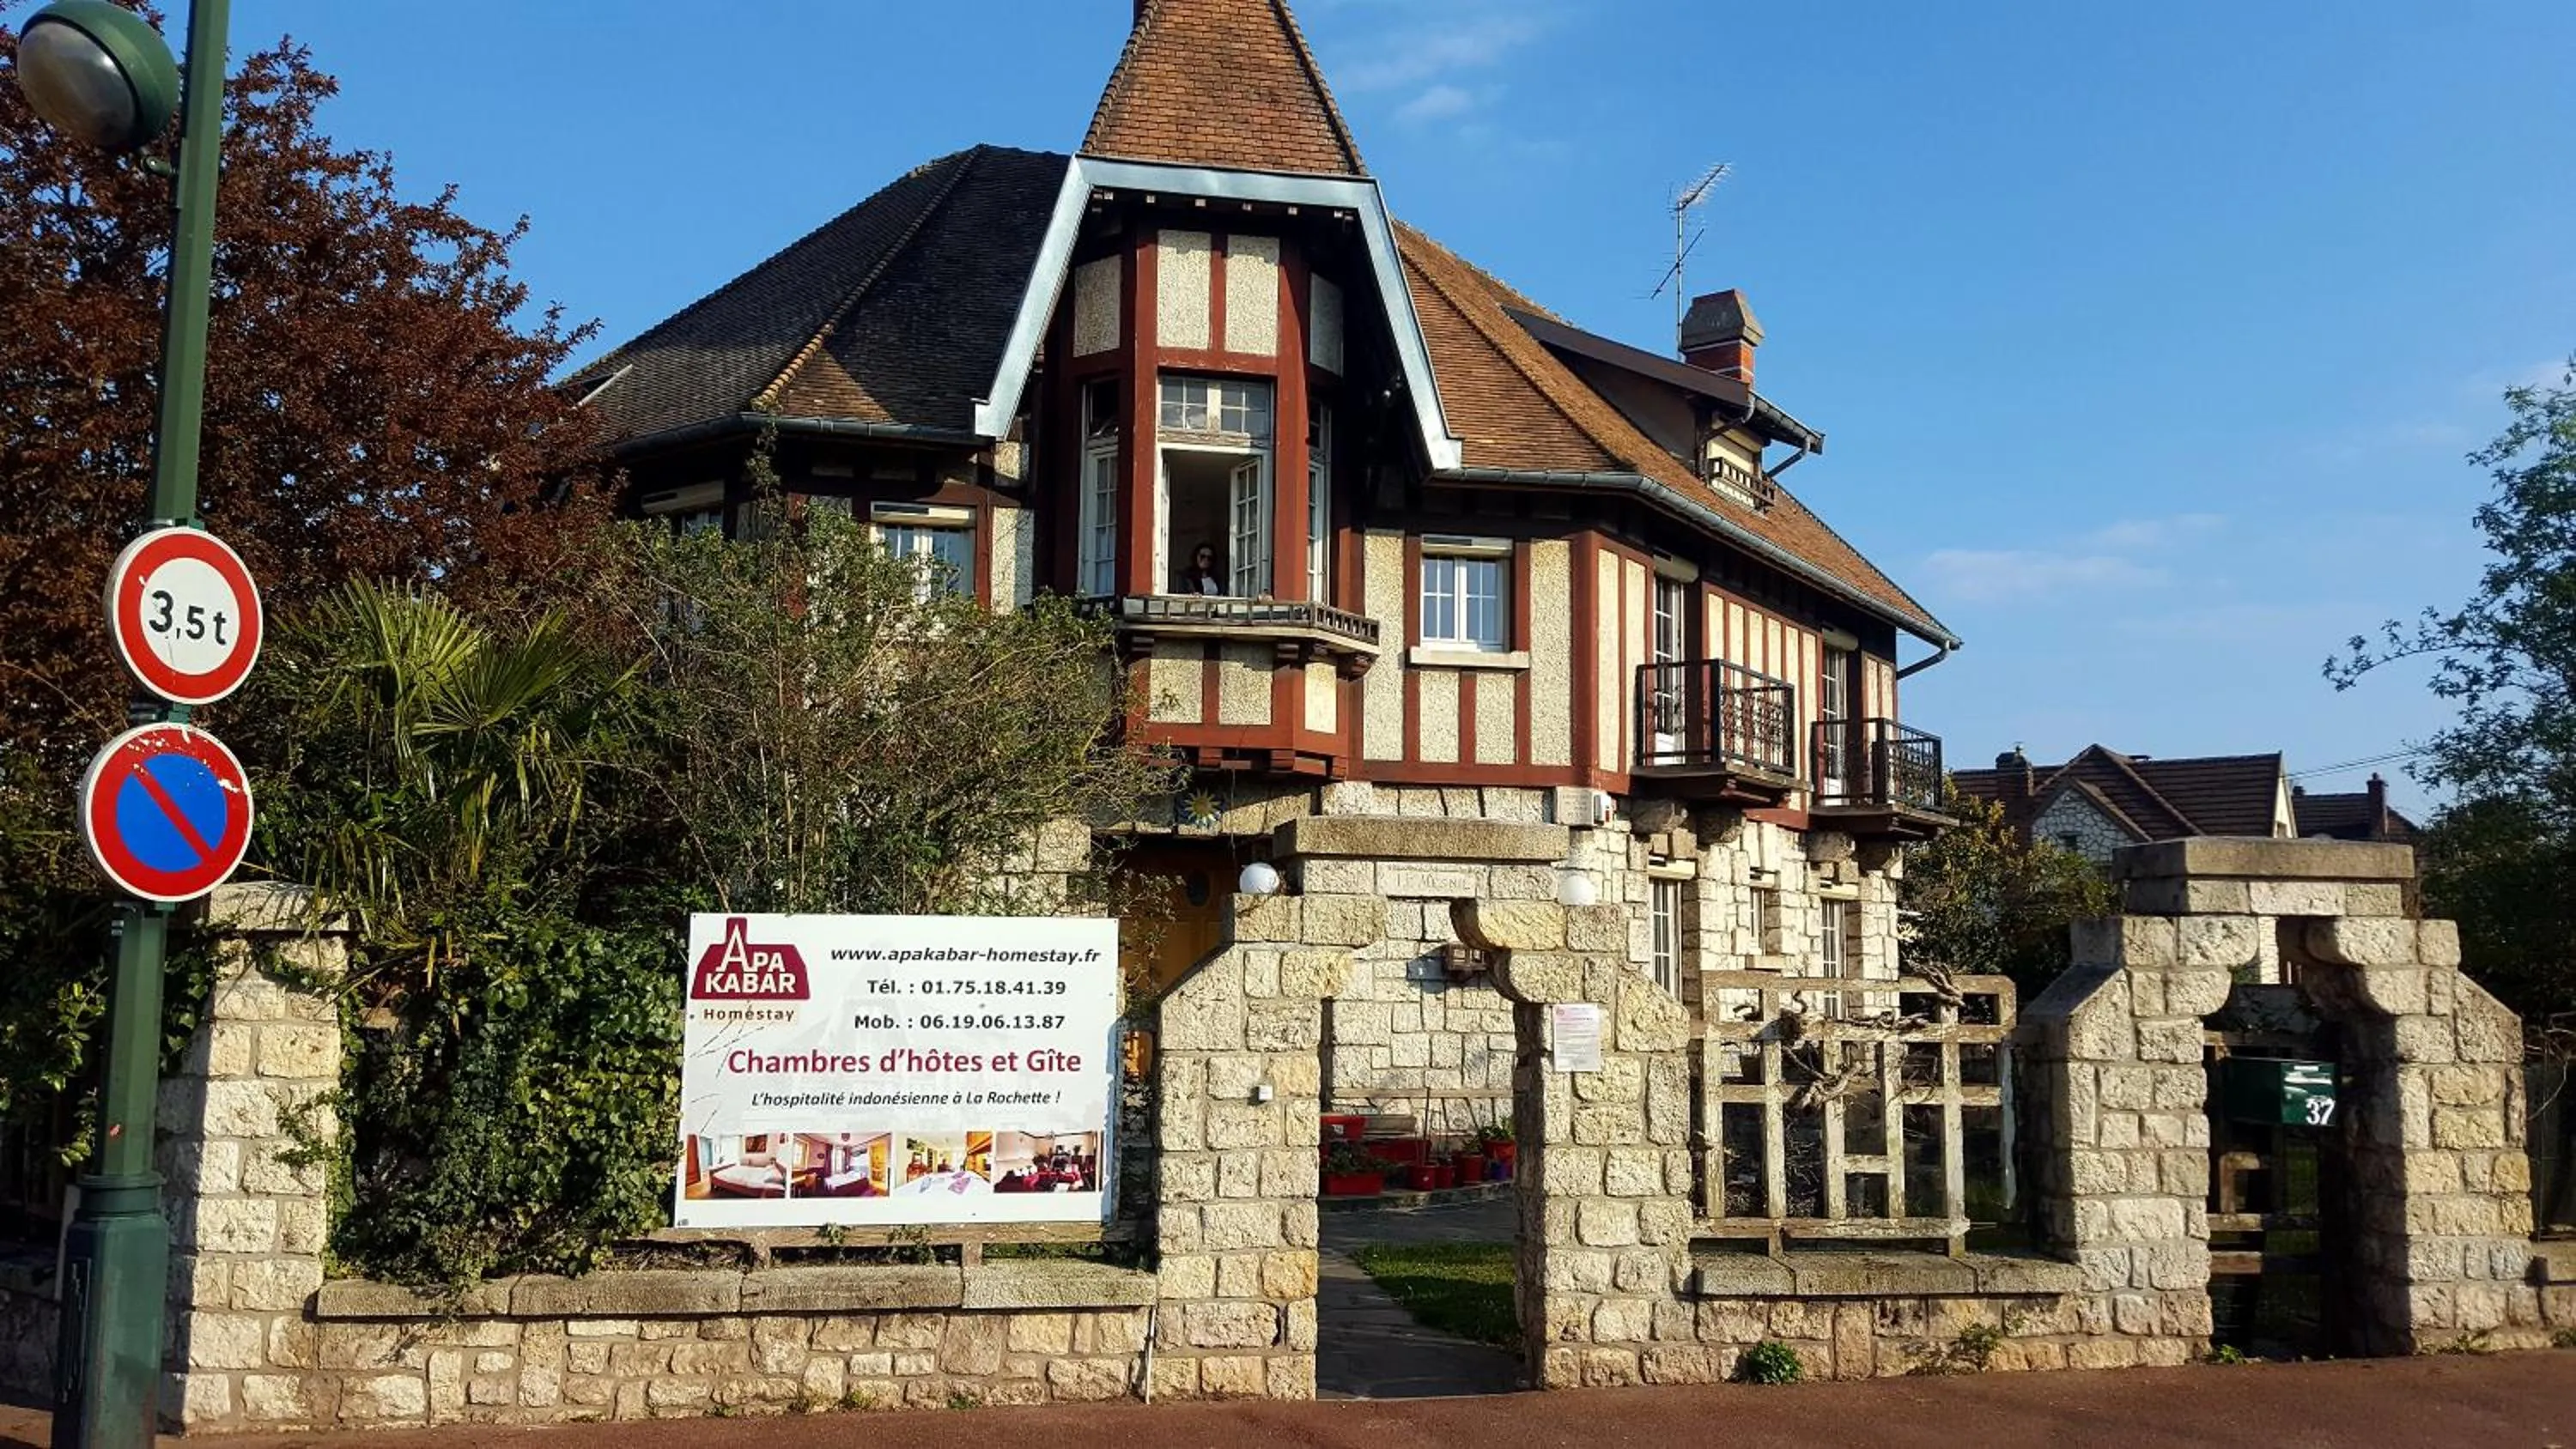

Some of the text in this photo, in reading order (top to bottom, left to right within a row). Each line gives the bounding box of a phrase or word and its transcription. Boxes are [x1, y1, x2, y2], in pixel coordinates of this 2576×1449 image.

[830, 948, 1101, 965] www.apakabar-homestay.fr
[705, 973, 796, 993] KABAR
[867, 979, 901, 994] Tél.
[921, 981, 1066, 995] 01.75.18.41.39
[854, 1015, 900, 1029] Mob.
[920, 1015, 1065, 1029] 06.19.06.13.87
[729, 1048, 1081, 1073] Chambres d'hôtes et Gîte
[751, 1091, 845, 1107] L'hospitalité
[848, 1091, 948, 1106] indonésienne
[952, 1091, 963, 1105] à
[966, 1091, 983, 1105] La
[987, 1091, 1051, 1105] Rochette
[2306, 1097, 2336, 1125] 37
